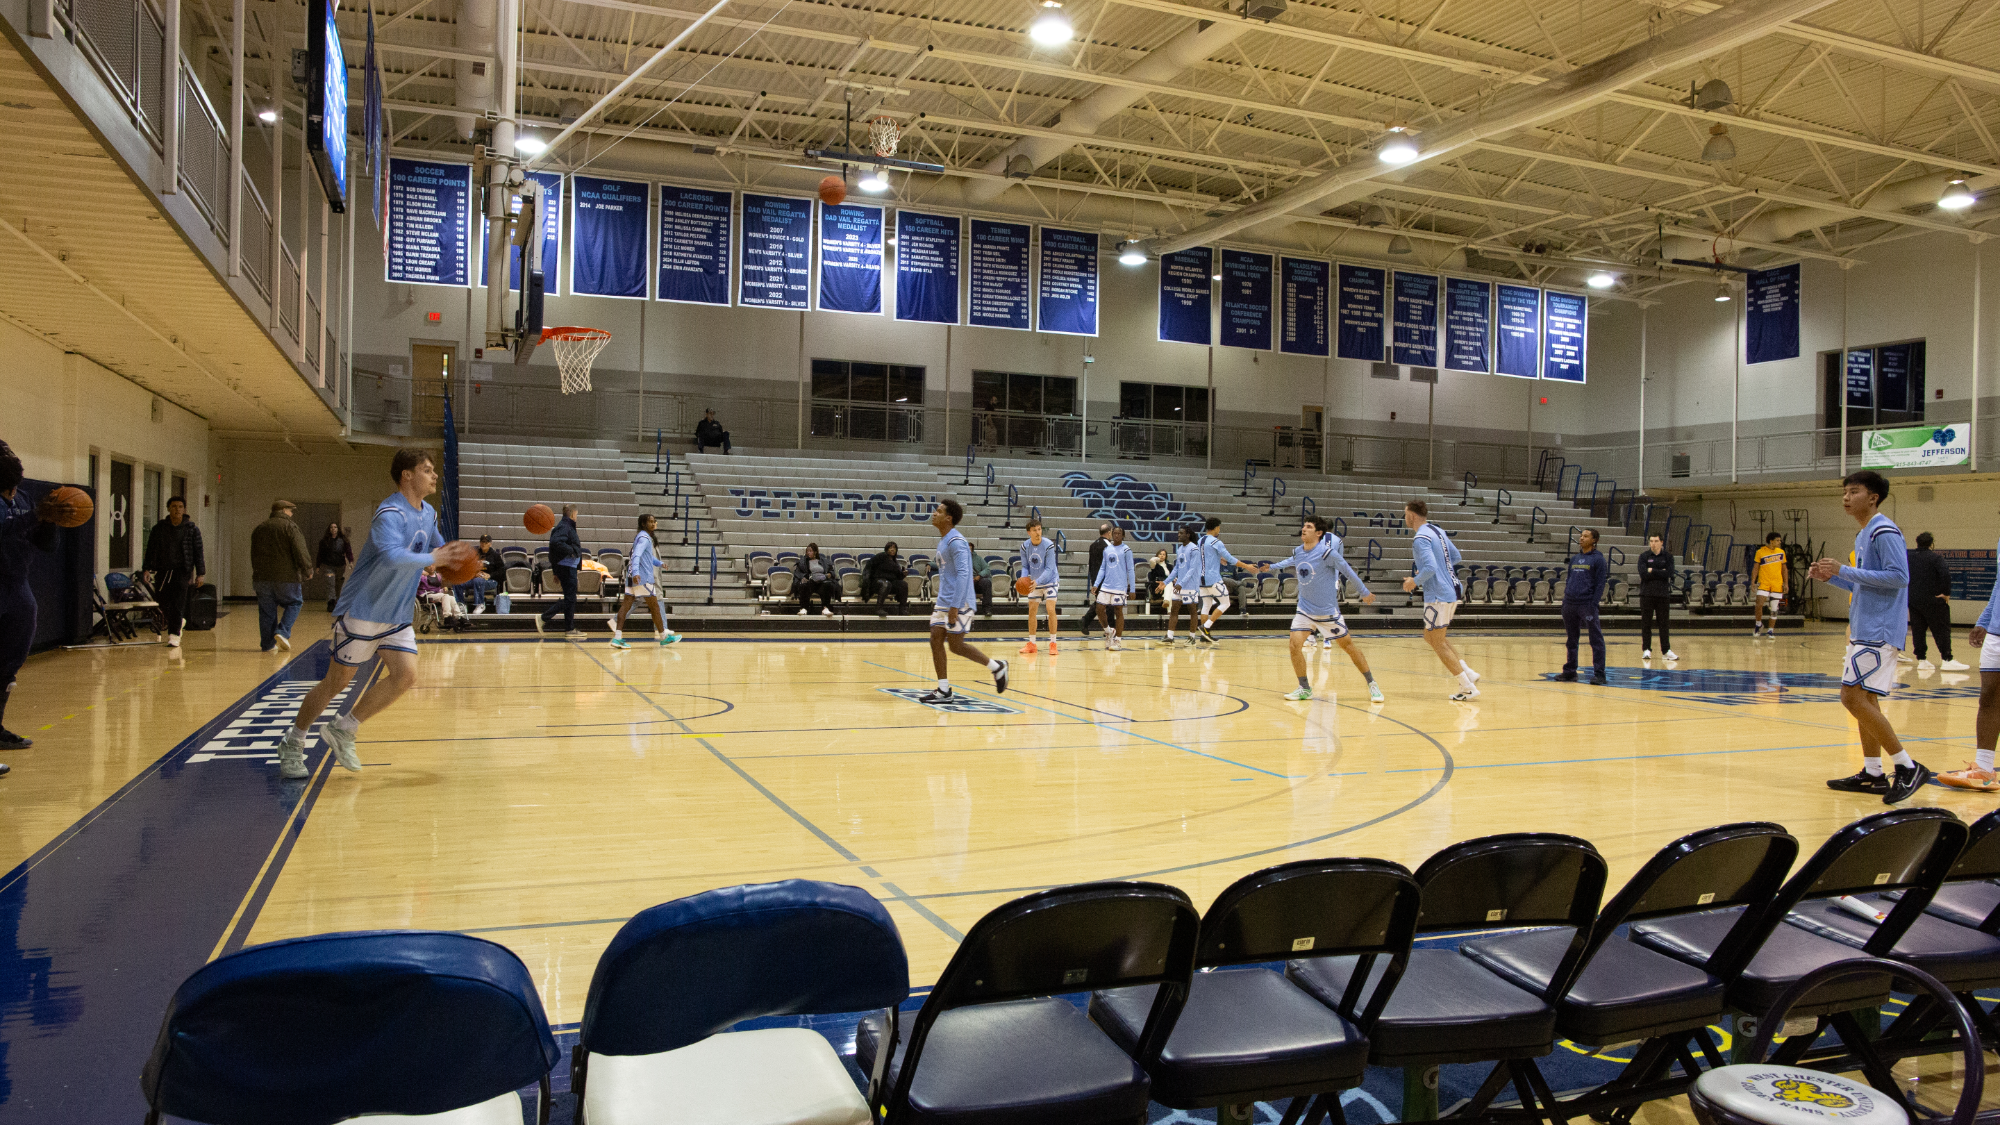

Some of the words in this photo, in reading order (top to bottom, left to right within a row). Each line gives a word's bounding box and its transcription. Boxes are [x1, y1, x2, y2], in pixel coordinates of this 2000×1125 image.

[415, 167, 444, 176] SOCCER
[408, 176, 437, 184] CAREER
[602, 193, 641, 202] QUALIFIERS
[680, 193, 713, 202] LACROSSE
[765, 201, 790, 210] ROWING
[778, 210, 806, 218] REGATTA
[762, 216, 792, 224] MEDALIST
[915, 218, 944, 226] SOFTBALL
[1053, 234, 1086, 243] VOLLEYBALL
[1289, 262, 1321, 270] PHILADELPHIA
[1403, 282, 1429, 290] CONFERENCE
[1231, 310, 1262, 318] CONFERENCE
[1922, 448, 1965, 457] JEFFERSON
[729, 489, 938, 521] JEFFERSON
[185, 681, 357, 764] JEFFERSON
[1741, 1082, 1778, 1102] GOLDEN
[1780, 1102, 1824, 1115] RAMS
[1747, 1073, 1780, 1081] WEST
[1784, 1073, 1854, 1091] CHESTER
[1839, 1092, 1874, 1118] UNIVERSITY
